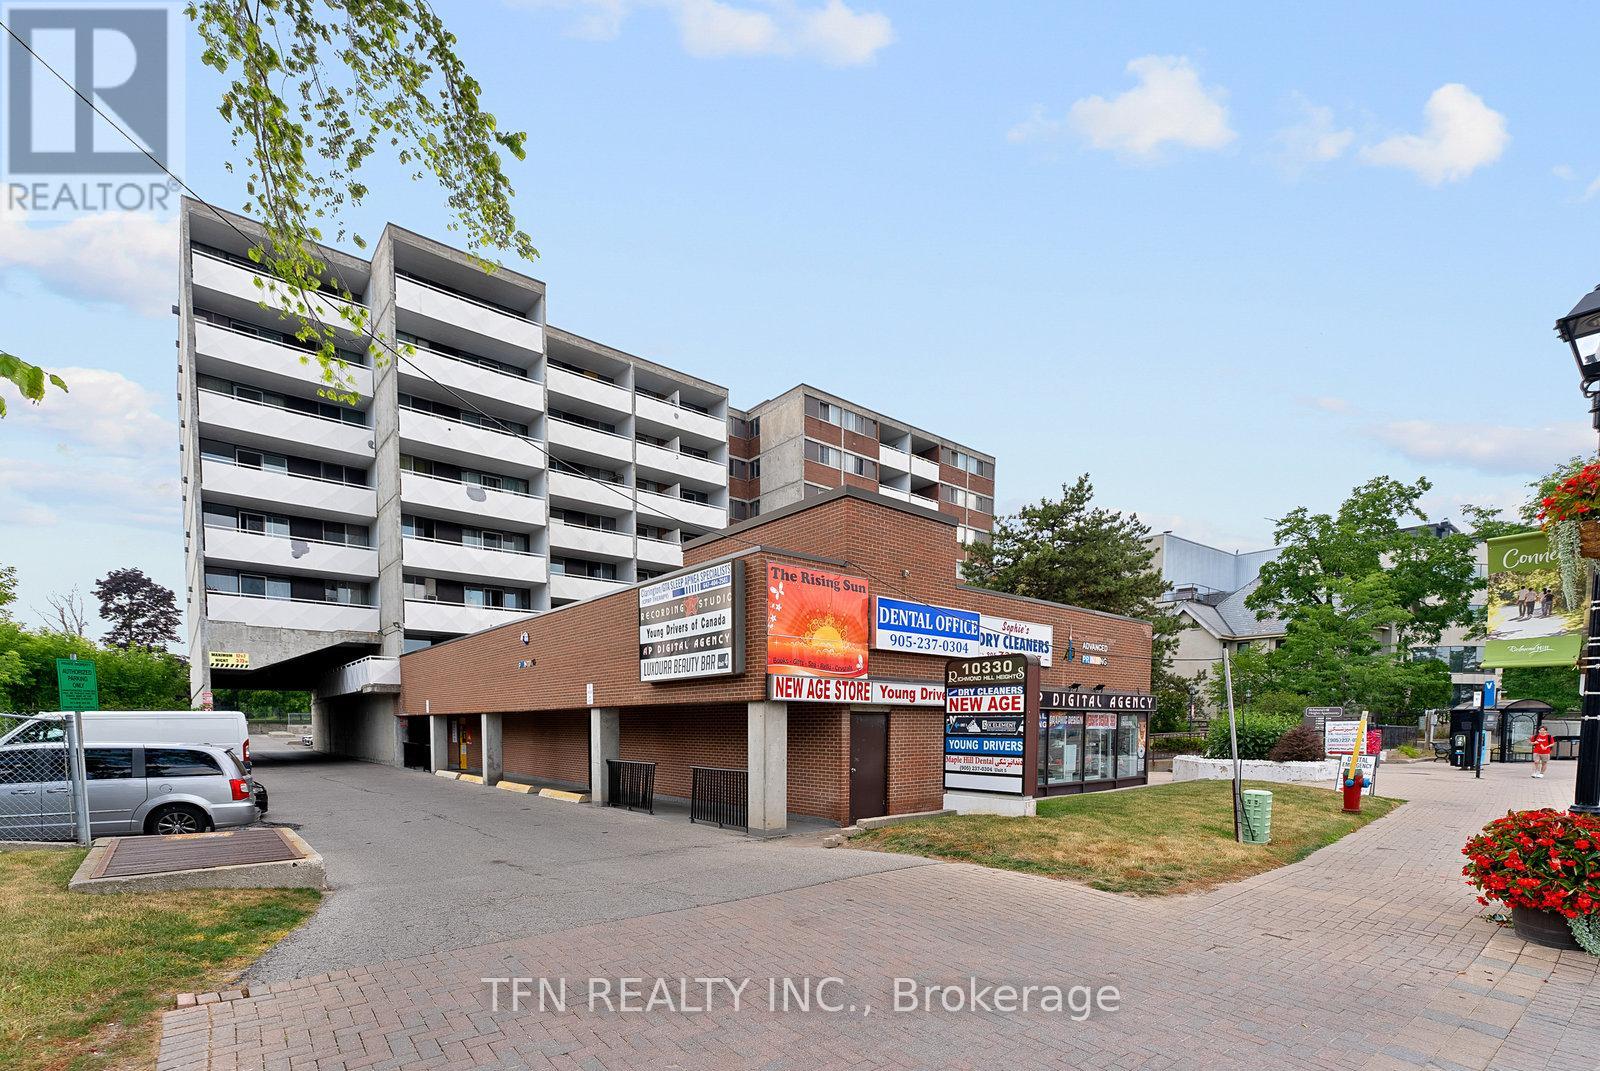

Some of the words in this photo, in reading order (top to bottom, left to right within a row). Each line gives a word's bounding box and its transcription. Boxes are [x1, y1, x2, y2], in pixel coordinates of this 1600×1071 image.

[1503, 548, 1560, 569] Conne
[670, 579, 684, 590] SLEEP
[685, 574, 700, 584] APNEA
[700, 564, 731, 582] SPECIALISTS
[770, 566, 798, 582] The
[800, 571, 841, 592] Rising
[843, 580, 866, 594] Sun
[641, 604, 684, 621] RECORDING
[879, 606, 933, 630] DENTAL
[935, 615, 978, 636] OFFICE
[646, 628, 664, 639] Young
[666, 623, 688, 636] Drivers
[691, 618, 698, 631] of
[700, 615, 726, 629] Canada
[1001, 620, 1030, 635] Sophie's
[642, 645, 653, 656] AP
[657, 640, 689, 654] DIGITAL
[693, 632, 730, 648] AGENCY
[889, 633, 969, 654] 905-237-0304
[980, 632, 1000, 648] DRY
[1003, 634, 1050, 654] CLEANERS
[1082, 642, 1108, 652] ADVANCED
[673, 655, 700, 674] BEAUTY
[701, 654, 716, 671] BAR
[961, 660, 1013, 675] 10330
[1082, 655, 1108, 666] PRNG
[775, 676, 804, 698] NEW
[807, 678, 831, 699] AGE
[835, 680, 870, 701] STORE
[880, 685, 916, 703] Young
[920, 687, 946, 701] Drive
[958, 688, 977, 696] DRY
[977, 686, 1024, 696] CLEANERS
[949, 696, 983, 712] NEW
[987, 695, 1021, 711] AGE
[1052, 693, 1102, 708] DIGITAL
[1109, 695, 1153, 709] AGENCY
[949, 739, 979, 750] YOUNG
[983, 740, 1023, 752] DRIVERS
[946, 755, 962, 765] Maple
[963, 756, 974, 764] Hill
[975, 756, 994, 765] Dental
[1342, 761, 1372, 769] EMGENCY
[1347, 756, 1368, 764] DTAL
